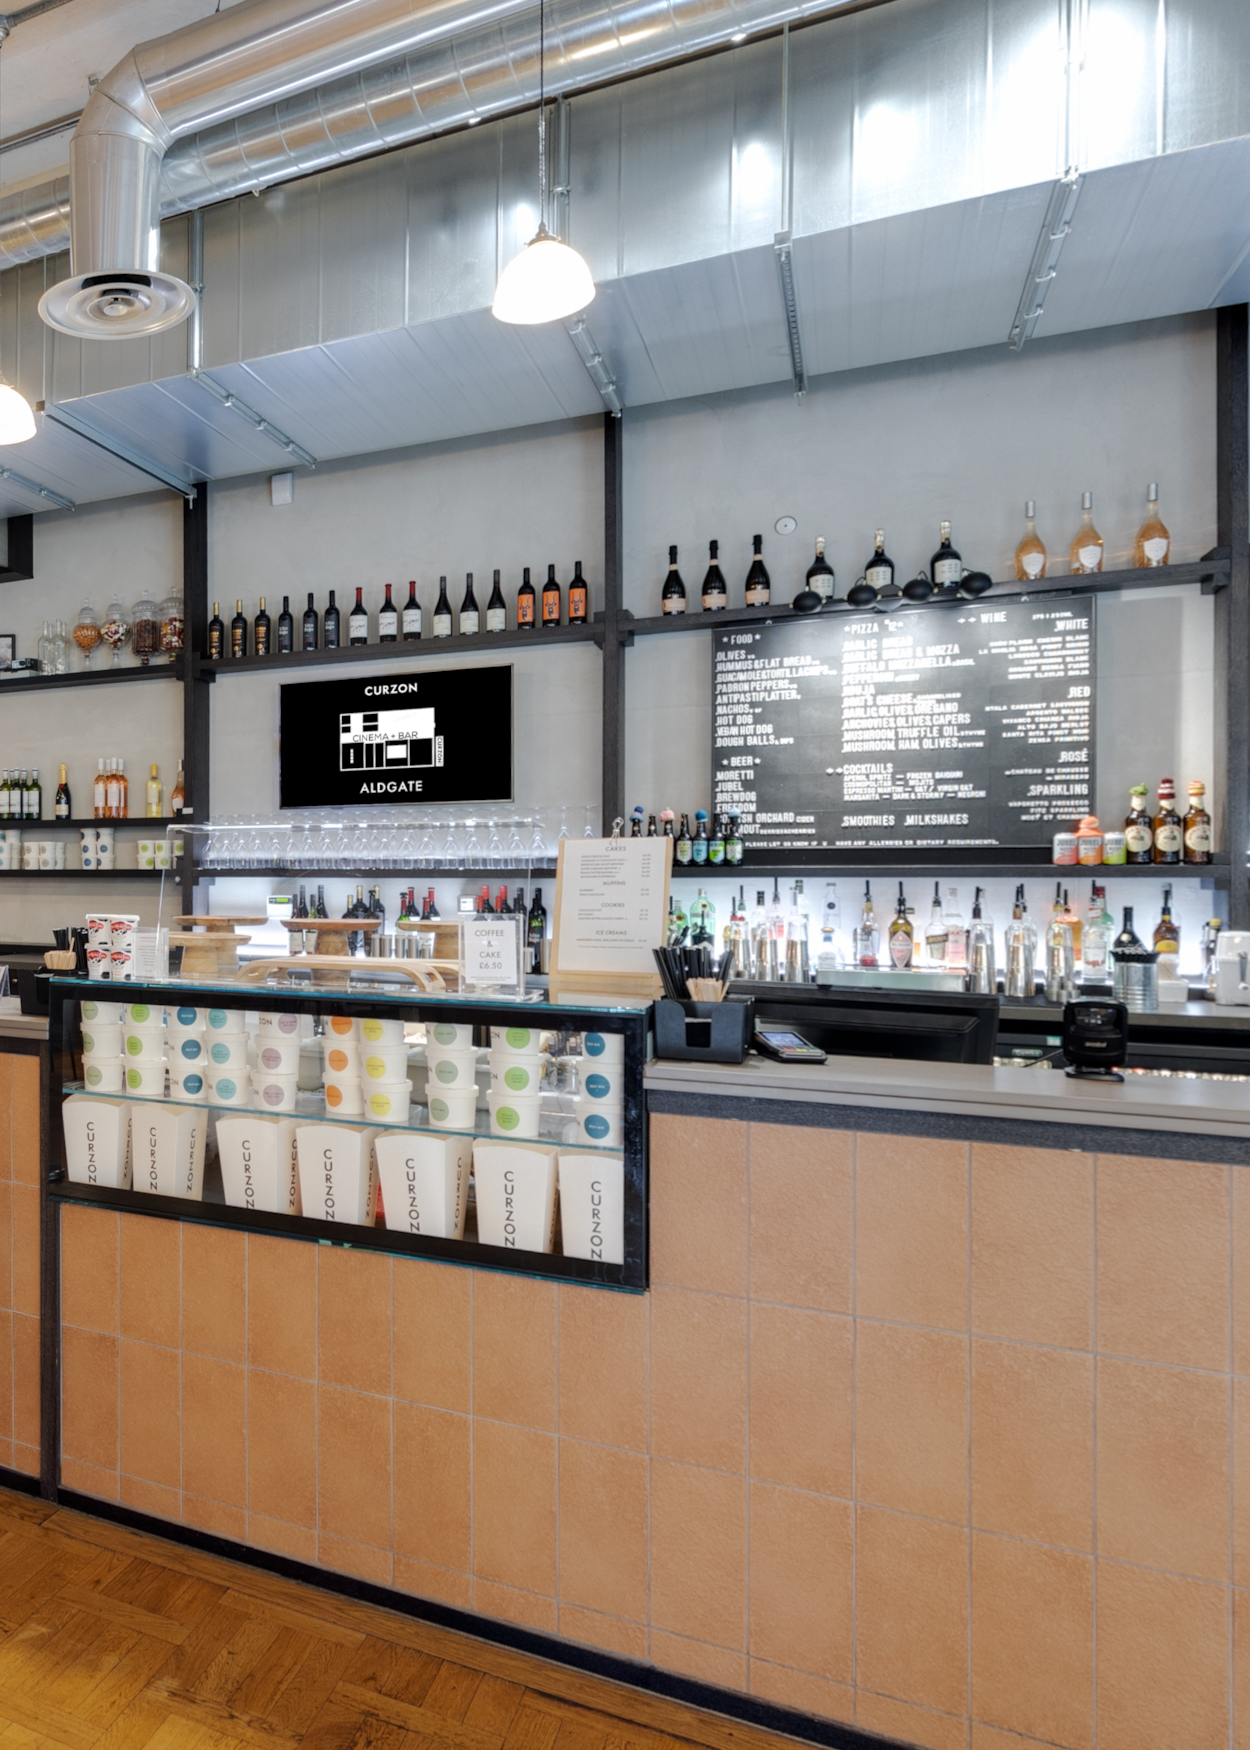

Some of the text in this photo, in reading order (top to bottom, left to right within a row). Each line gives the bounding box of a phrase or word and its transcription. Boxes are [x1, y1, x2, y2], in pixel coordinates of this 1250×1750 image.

[980, 611, 1007, 623] WINE
[851, 622, 879, 635] PIZZA
[1055, 618, 1089, 631] WHITE
[731, 634, 753, 645] FOOD
[716, 650, 746, 661] OLIVES
[717, 660, 752, 672] HUMMUS
[364, 682, 418, 696] CURZON
[716, 679, 790, 693] PADRON PEPPERS
[1069, 686, 1090, 698] RED
[716, 704, 750, 715] NACHOS
[716, 714, 753, 726] HOT DOG
[932, 713, 971, 725] CAPERS
[716, 724, 773, 737] VEGAN HOT DOG
[897, 726, 940, 738] TRUFFLE
[943, 726, 959, 737] OIL
[352, 732, 389, 743] CINEMA
[398, 731, 418, 740] BAR
[716, 735, 775, 747] DOUGH BALLS
[922, 737, 958, 749] OLIVES
[1060, 748, 1089, 762] ROSÉ
[731, 756, 753, 767] BEER
[843, 763, 893, 775] COCKTAILS
[716, 770, 754, 781] MORETTI
[359, 780, 423, 794] ALDGATE
[716, 781, 744, 792] JUBEL
[1029, 784, 1089, 796] SPARKLING
[716, 792, 757, 802] BREWDOG
[755, 812, 795, 823] ORCHARD
[843, 814, 969, 827] SMOOTHIES MILKSHAKES
[474, 929, 505, 937] COFFEE
[486, 940, 493, 948] &
[479, 951, 501, 959] CAKE
[479, 962, 502, 970] £6.50
[86, 1121, 97, 1184] CURZON
[149, 1127, 158, 1191] CURZON
[186, 1129, 196, 1193] CURZON
[242, 1140, 255, 1209] CURZON
[289, 1138, 298, 1208] CURZON
[323, 1149, 336, 1220] CURZON
[405, 1158, 420, 1232] CURZON
[504, 1171, 516, 1247] CURZON
[590, 1181, 603, 1260] CURZON
